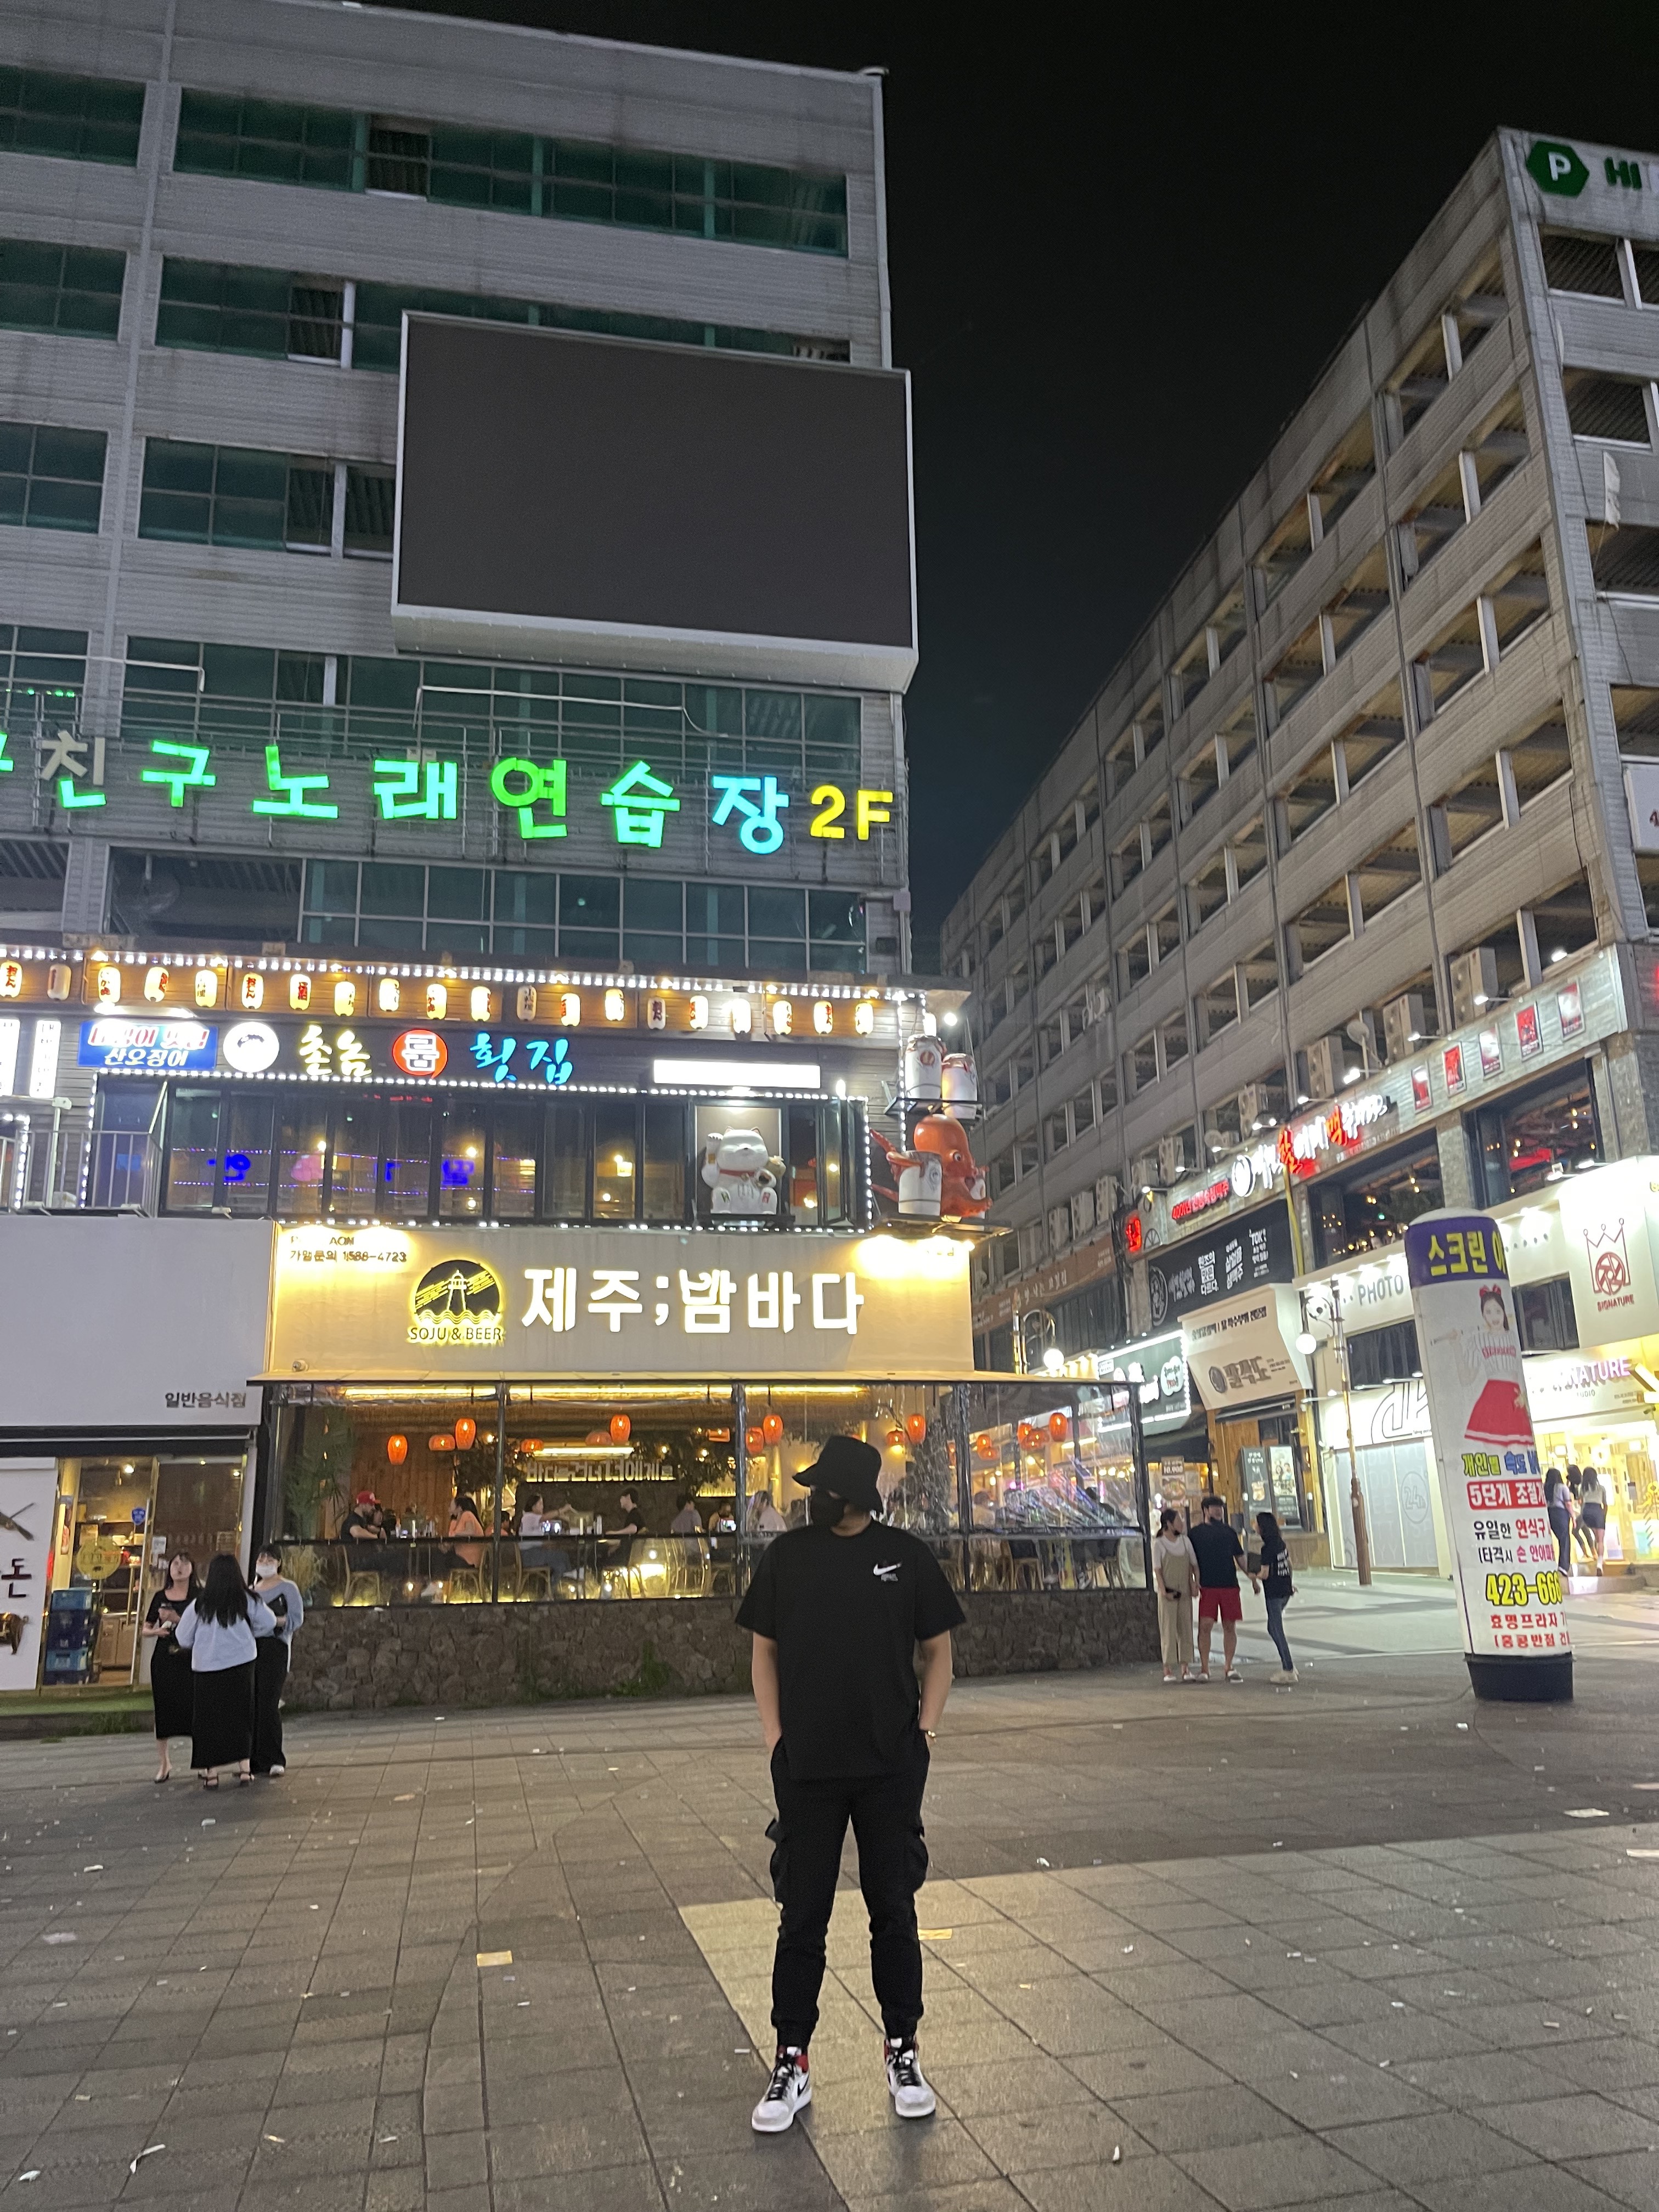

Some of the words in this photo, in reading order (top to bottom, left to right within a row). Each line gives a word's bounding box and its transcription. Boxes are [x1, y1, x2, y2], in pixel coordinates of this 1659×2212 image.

[1548, 151, 1571, 182] P
[810, 785, 893, 840] 2F
[104, 1047, 189, 1067] 산오징어
[401, 1033, 440, 1072] 룸
[470, 1031, 573, 1085] 횟집
[343, 1251, 407, 1262] 1588-4723
[1428, 1230, 1488, 1277] 스크린
[1358, 1274, 1404, 1306] PHOTO
[1597, 1294, 1635, 1312] SIGNATURE
[410, 1327, 447, 1340] SOJU
[451, 1327, 461, 1340] &
[466, 1327, 501, 1340] BEER
[165, 1391, 246, 1408] 일반음식점
[1469, 1482, 1512, 1506] 5단계
[1474, 1520, 1512, 1540] 유일한
[1516, 1545, 1527, 1563] 손
